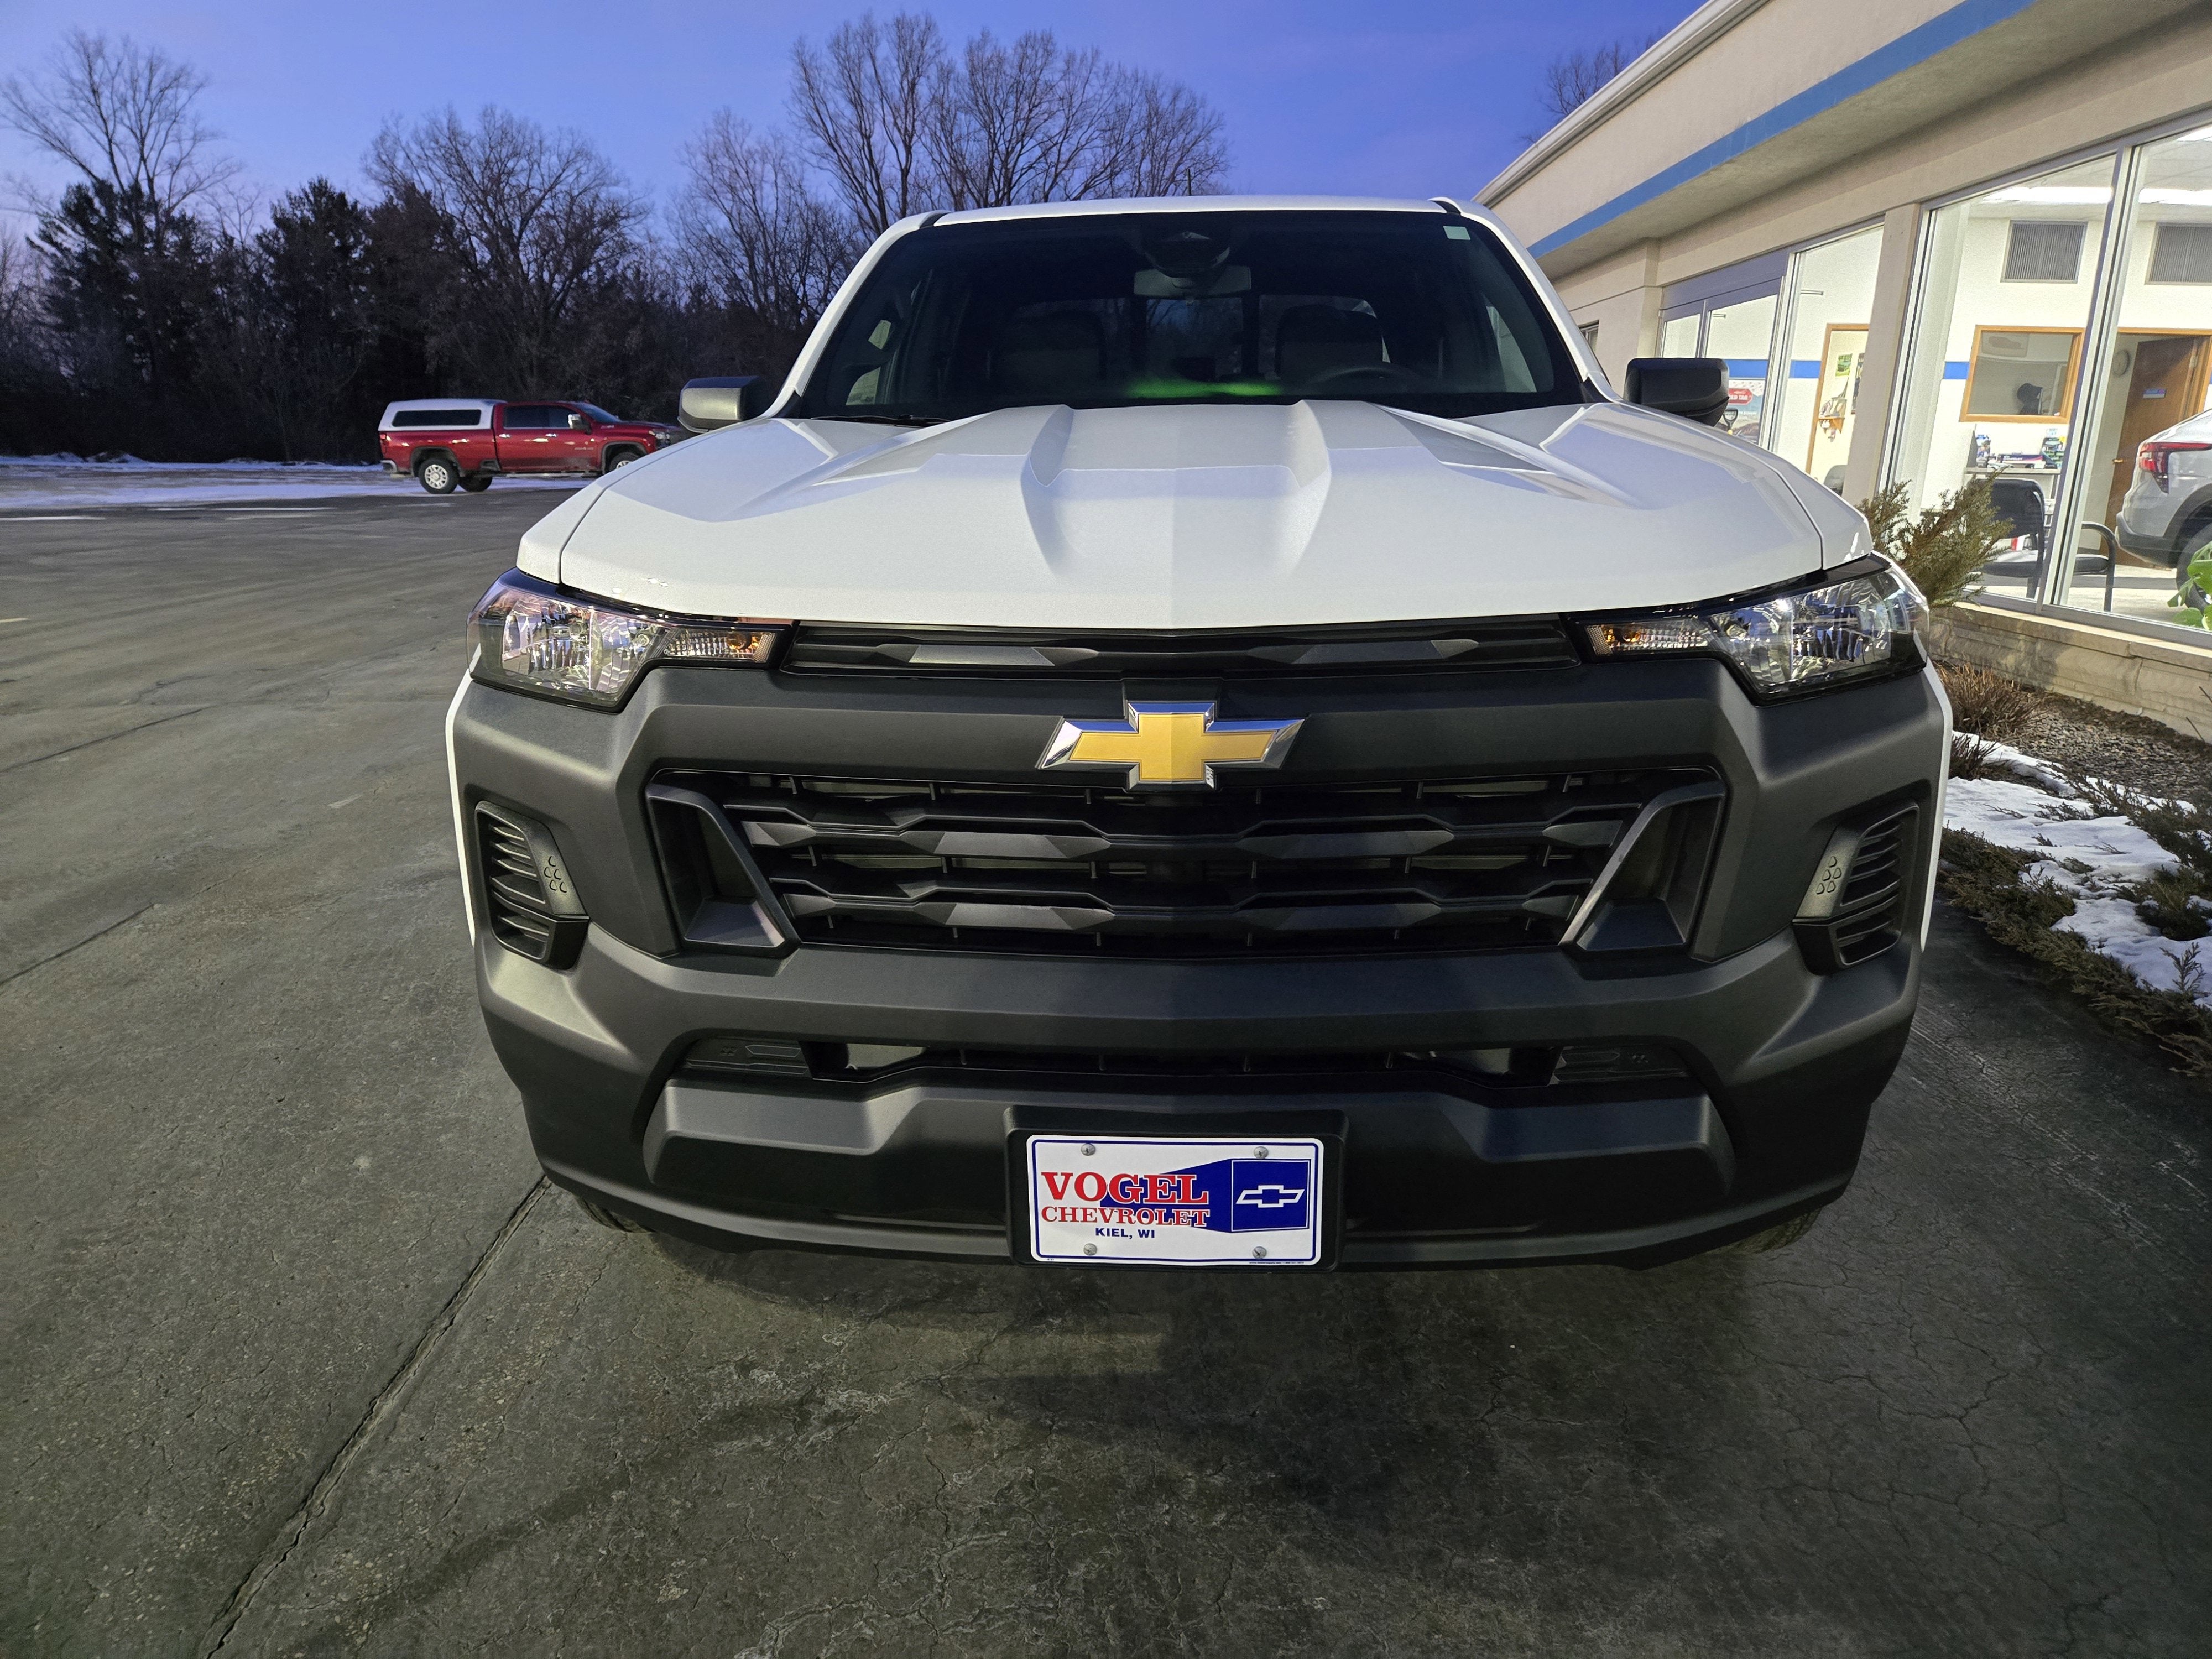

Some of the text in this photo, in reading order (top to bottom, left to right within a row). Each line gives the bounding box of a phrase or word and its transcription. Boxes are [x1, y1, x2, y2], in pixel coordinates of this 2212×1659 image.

[1041, 1172, 1209, 1204] VOGEL
[1041, 1206, 1209, 1226] CHEVROLET
[1095, 1228, 1155, 1239] KIEL, WI
